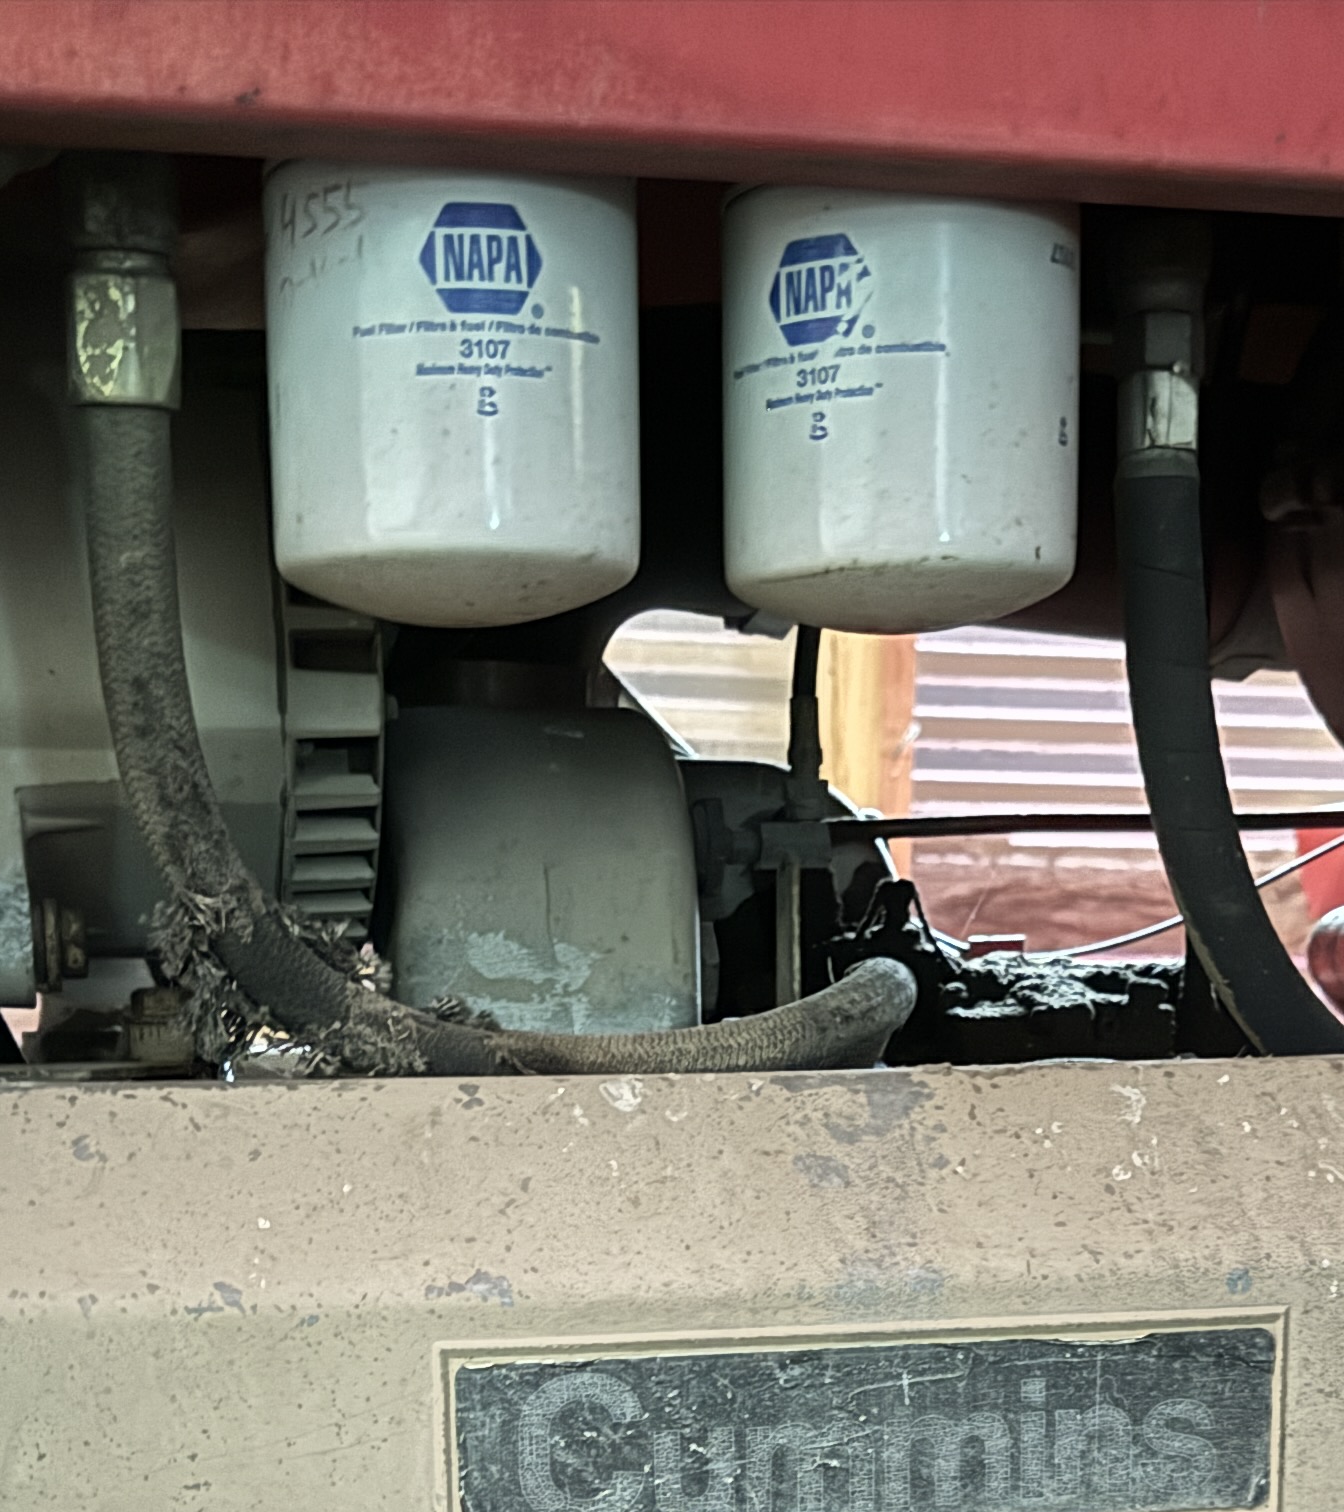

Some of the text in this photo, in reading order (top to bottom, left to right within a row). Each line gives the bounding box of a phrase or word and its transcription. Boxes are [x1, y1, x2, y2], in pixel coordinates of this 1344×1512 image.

[443, 233, 523, 285] NAPA
[459, 338, 511, 359] 3107
[796, 364, 841, 388] 3107
